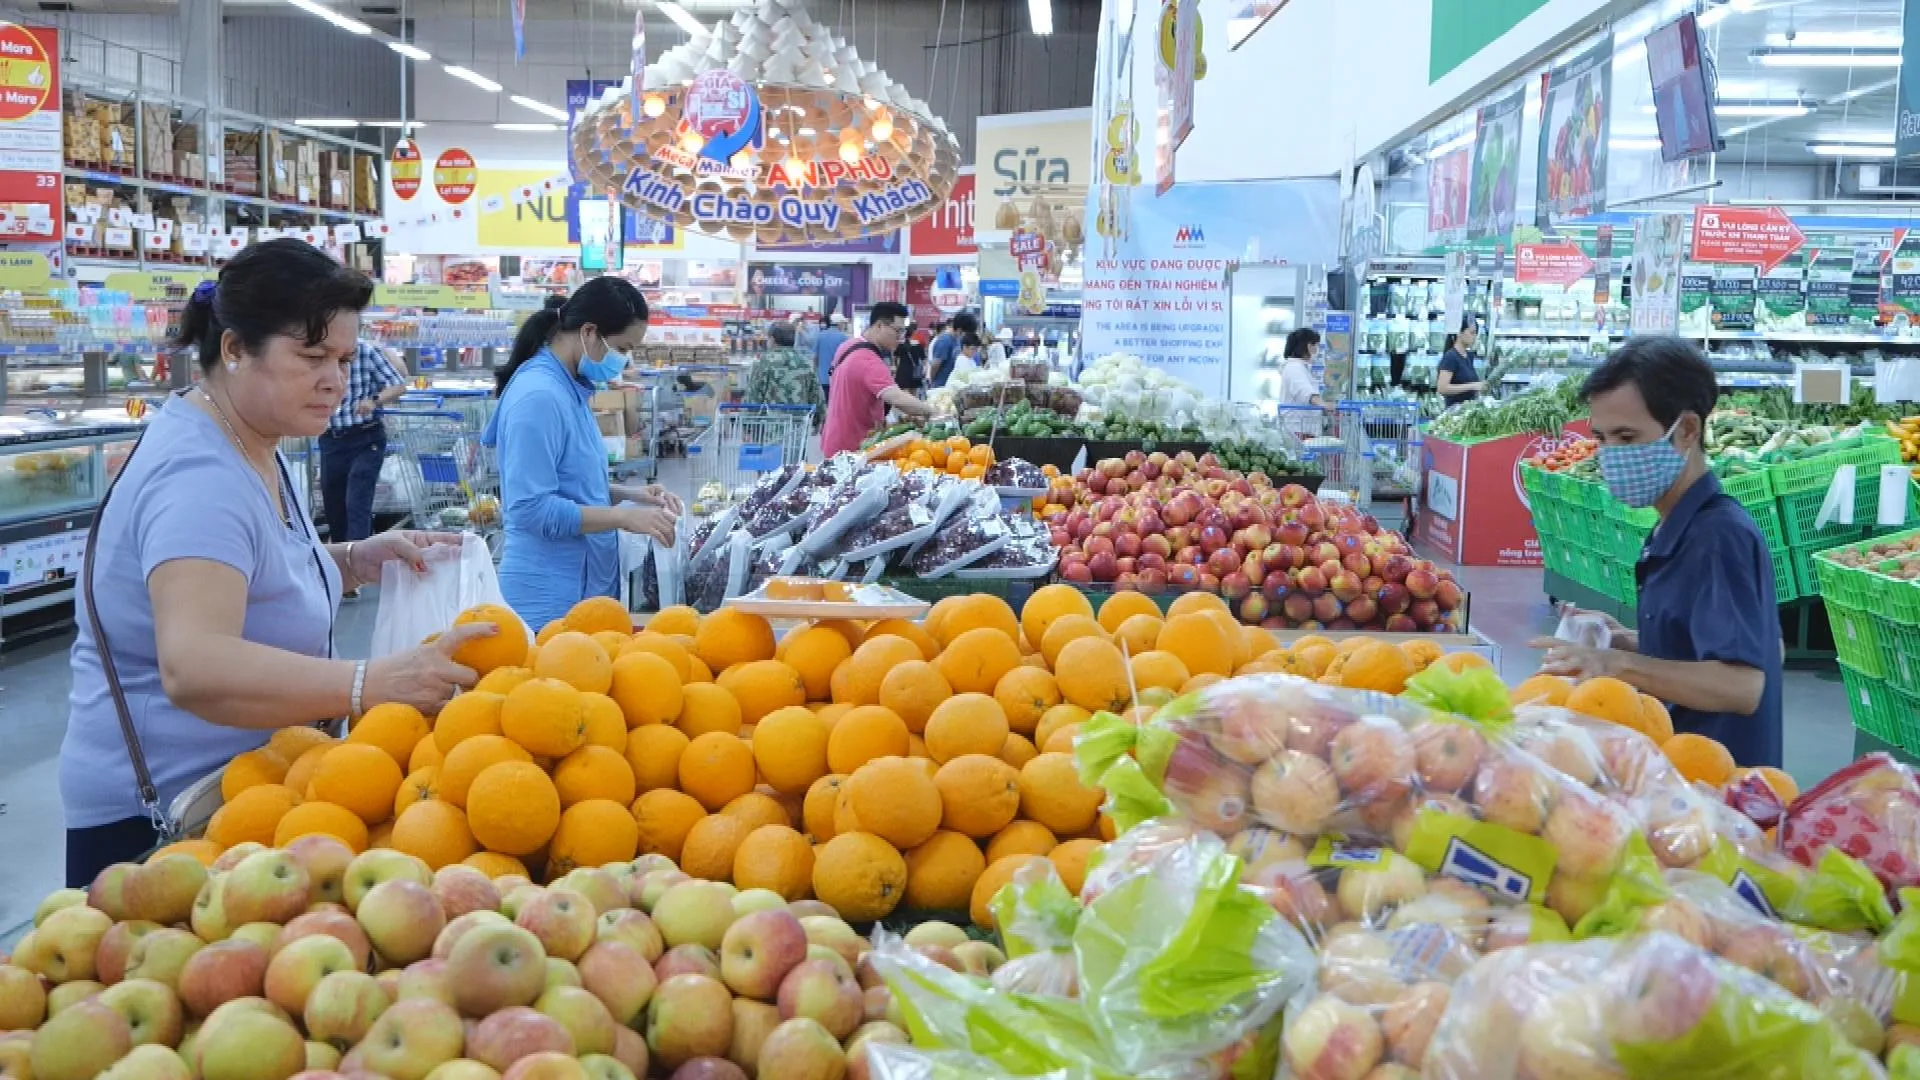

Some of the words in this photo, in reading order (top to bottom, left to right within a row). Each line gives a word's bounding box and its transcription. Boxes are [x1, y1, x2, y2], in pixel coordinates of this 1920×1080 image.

[1, 40, 33, 55] More
[6, 90, 37, 105] More
[700, 160, 759, 177] Maret
[994, 146, 1069, 196] Sữa
[1096, 259, 1118, 270] KHU
[1150, 259, 1183, 270] ĐANG
[1152, 300, 1171, 311] XIN
[1123, 337, 1157, 347] BETTER
[1160, 338, 1202, 350] SHOPPING
[1167, 355, 1186, 365] ANY
